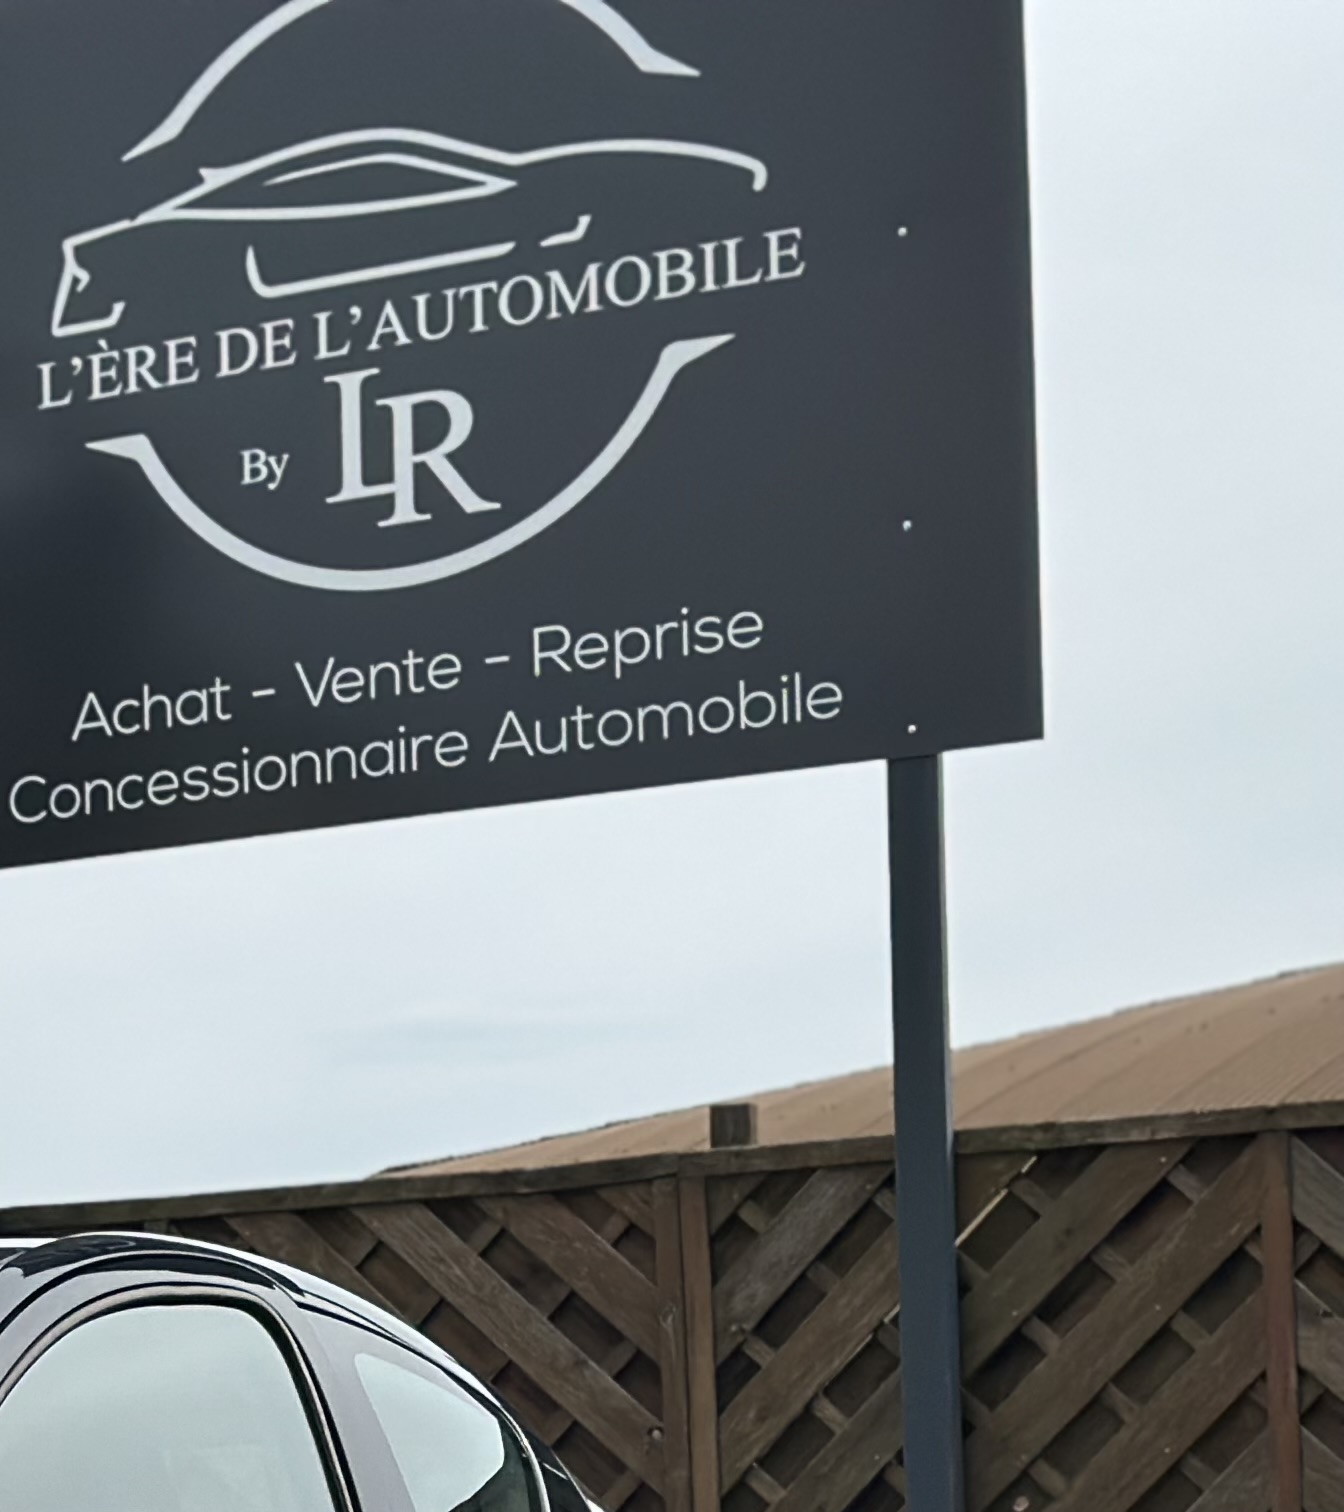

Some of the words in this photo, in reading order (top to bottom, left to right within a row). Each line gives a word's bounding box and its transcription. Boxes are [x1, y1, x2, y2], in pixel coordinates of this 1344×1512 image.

[36, 335, 200, 410] L'ÈRE
[215, 318, 297, 379] DE
[312, 226, 807, 362] L'AUTOMOBILE
[240, 448, 290, 490] By
[71, 676, 233, 742] Achat
[294, 649, 462, 708] Vente
[532, 606, 764, 680] Reprise
[9, 725, 470, 824] Concessionnaire
[488, 671, 844, 763] Automobile
